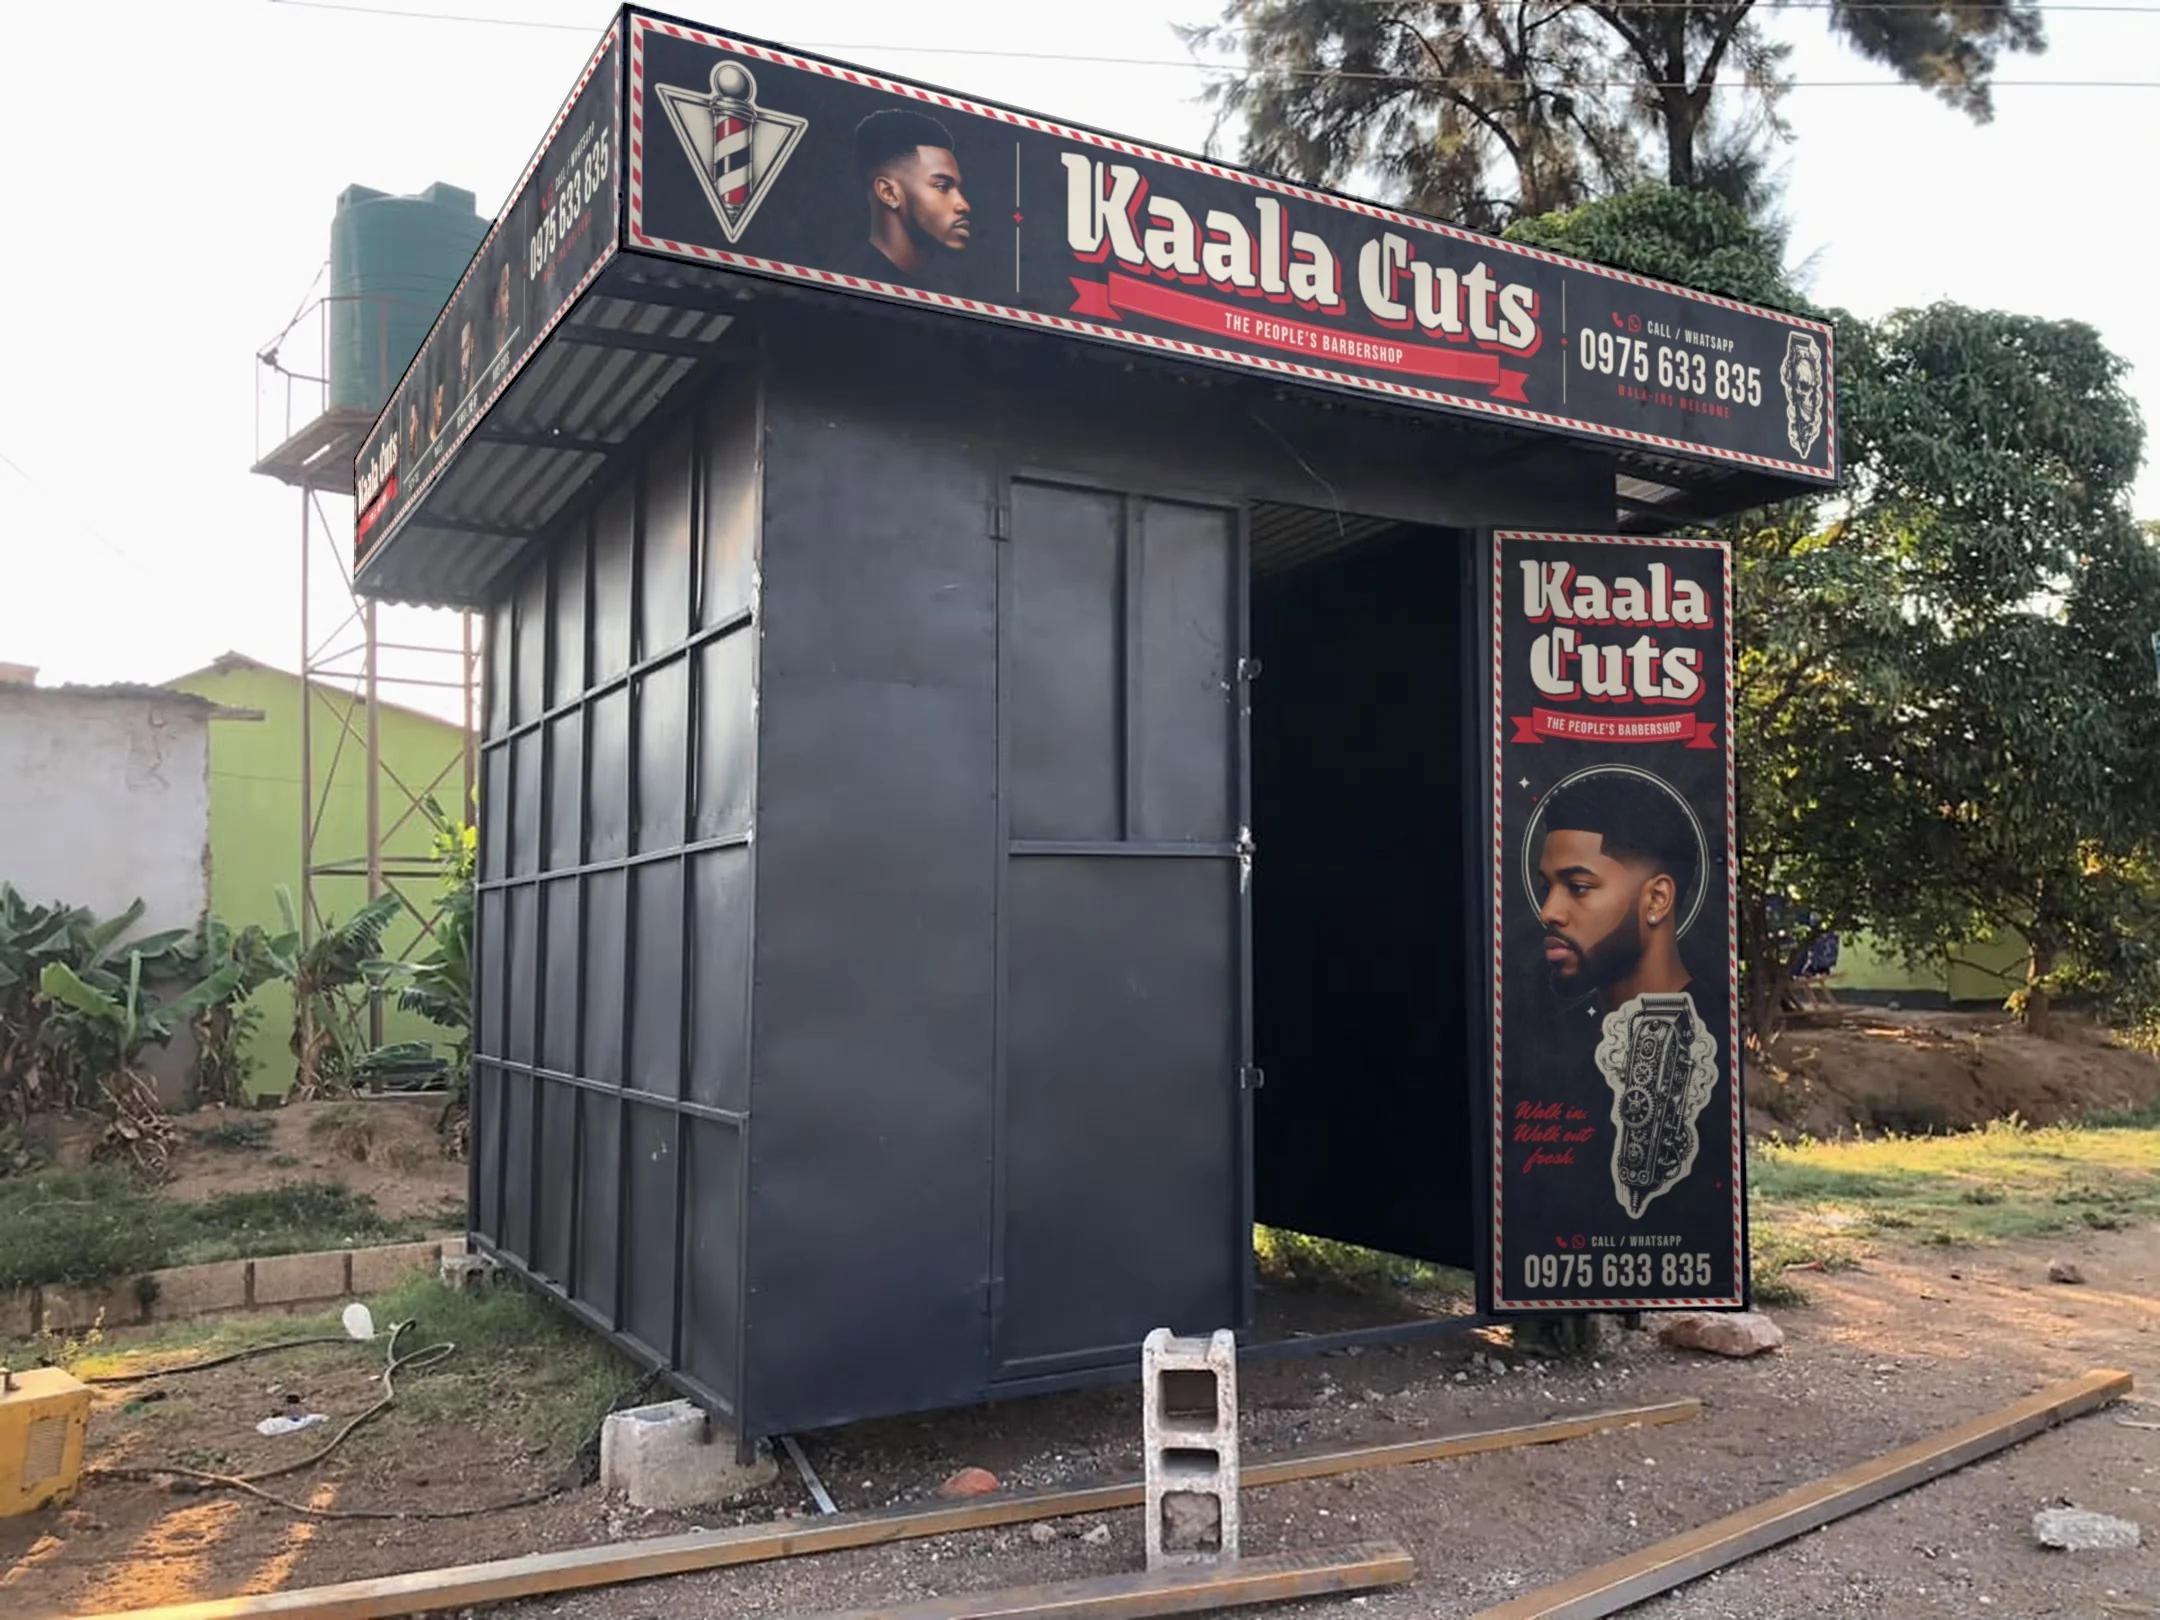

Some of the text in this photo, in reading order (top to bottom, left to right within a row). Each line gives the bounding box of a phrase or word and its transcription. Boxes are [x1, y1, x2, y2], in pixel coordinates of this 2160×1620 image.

[530, 205, 556, 281] 0975
[559, 169, 581, 239] 633
[584, 126, 609, 204] 835
[1061, 152, 1538, 352] Kaala Cuts
[1225, 312, 1403, 364] THE PEOPLE'S BARBERSHOP
[1647, 320, 1734, 352] CALL / WHATSAPP
[1580, 327, 1762, 407] 0975 633 835
[1618, 384, 1730, 419] WALK-INS WELCOME
[1519, 559, 1711, 627] Kaala
[1530, 626, 1703, 702] Cuts
[1547, 716, 1682, 736] THE PEOPLE'S BARBERSHOP
[1515, 1101, 1564, 1120] Walk
[1513, 1123, 1596, 1143] Walk out
[1591, 1235, 1682, 1248] CALL / WHATSAPP
[1524, 1253, 1711, 1288] 0975 633 835
